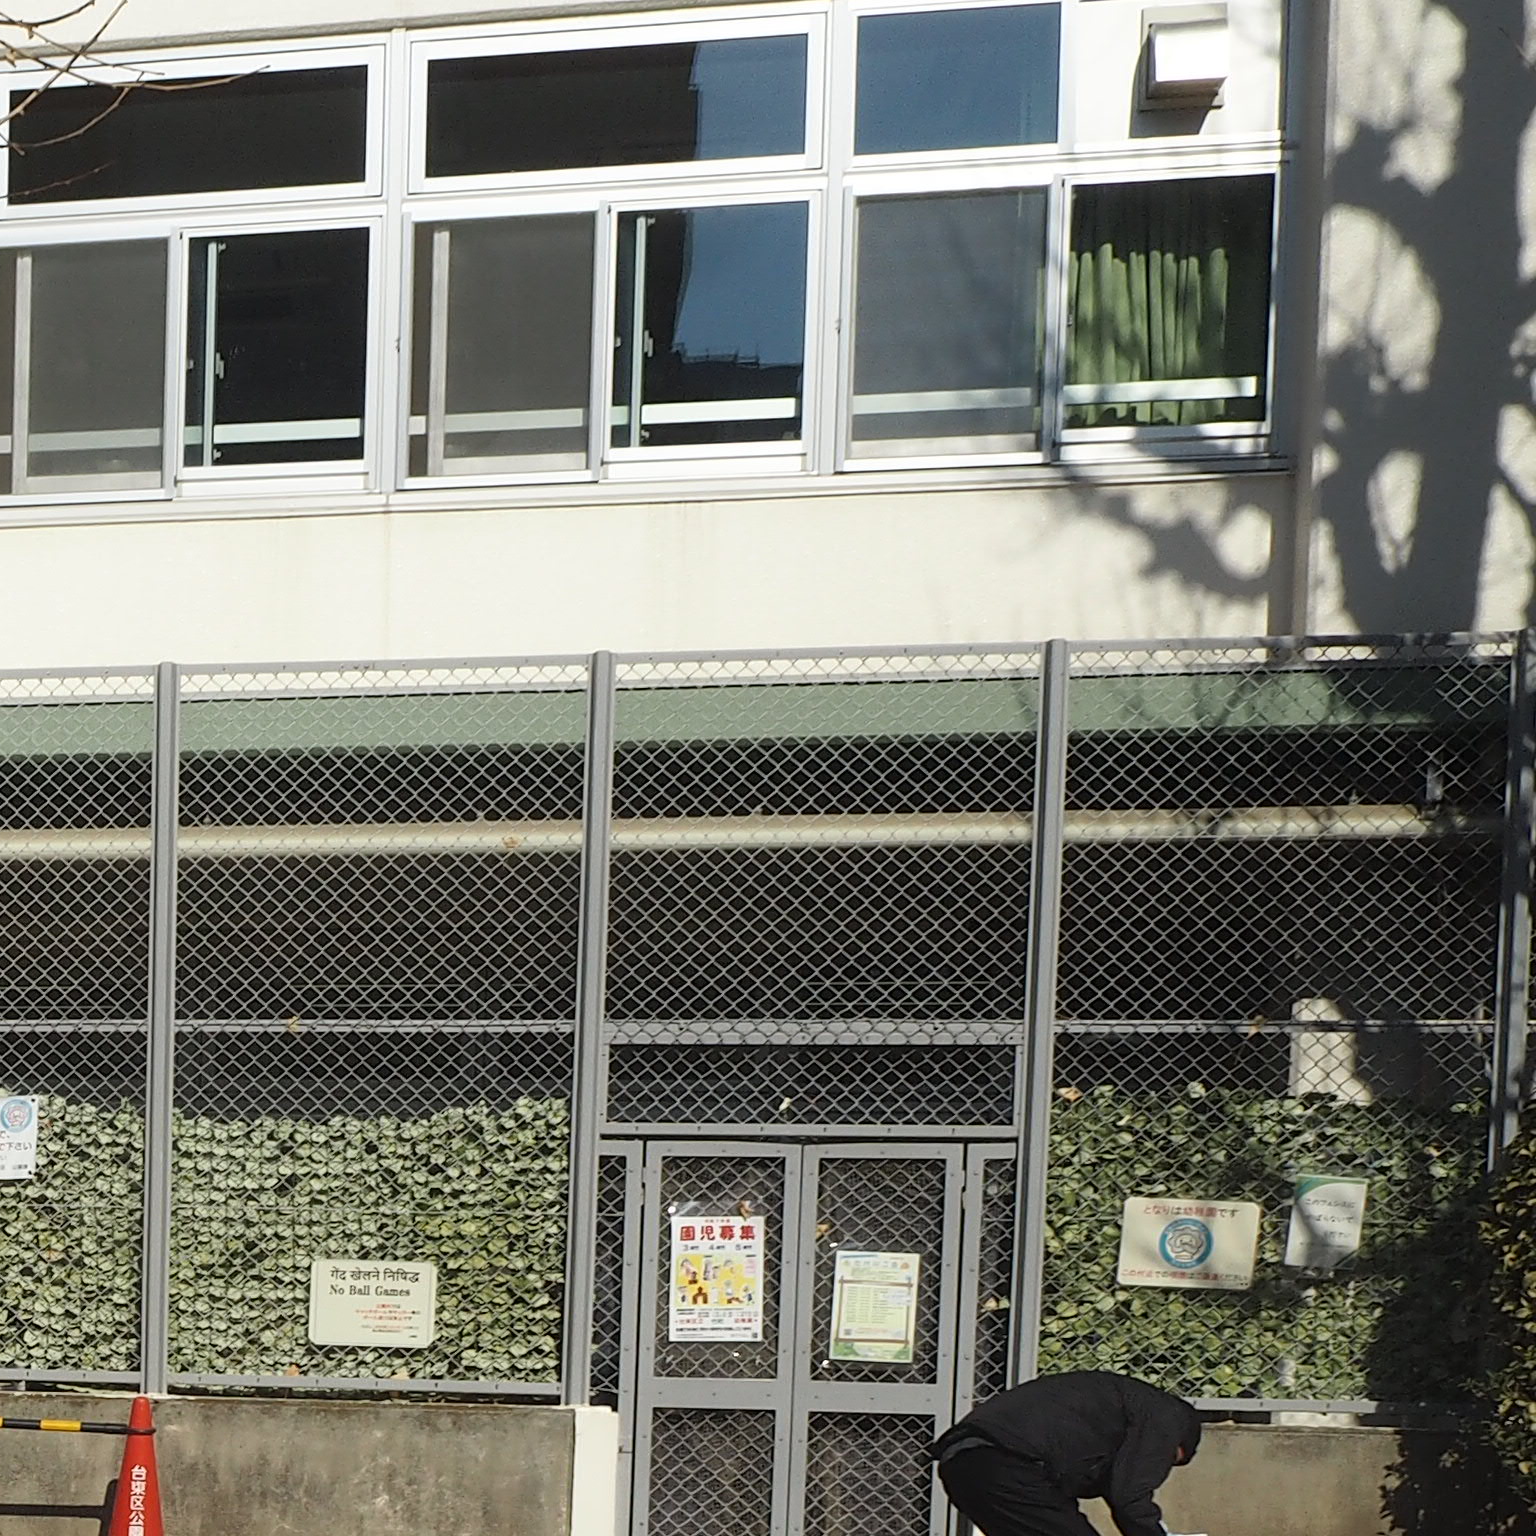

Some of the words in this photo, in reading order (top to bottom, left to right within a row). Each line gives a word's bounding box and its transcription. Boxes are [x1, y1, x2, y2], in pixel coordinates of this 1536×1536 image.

[680, 1224, 756, 1241] 園児募集
[329, 1284, 345, 1295] No
[349, 1285, 370, 1296] Ball
[375, 1285, 411, 1297] Games
